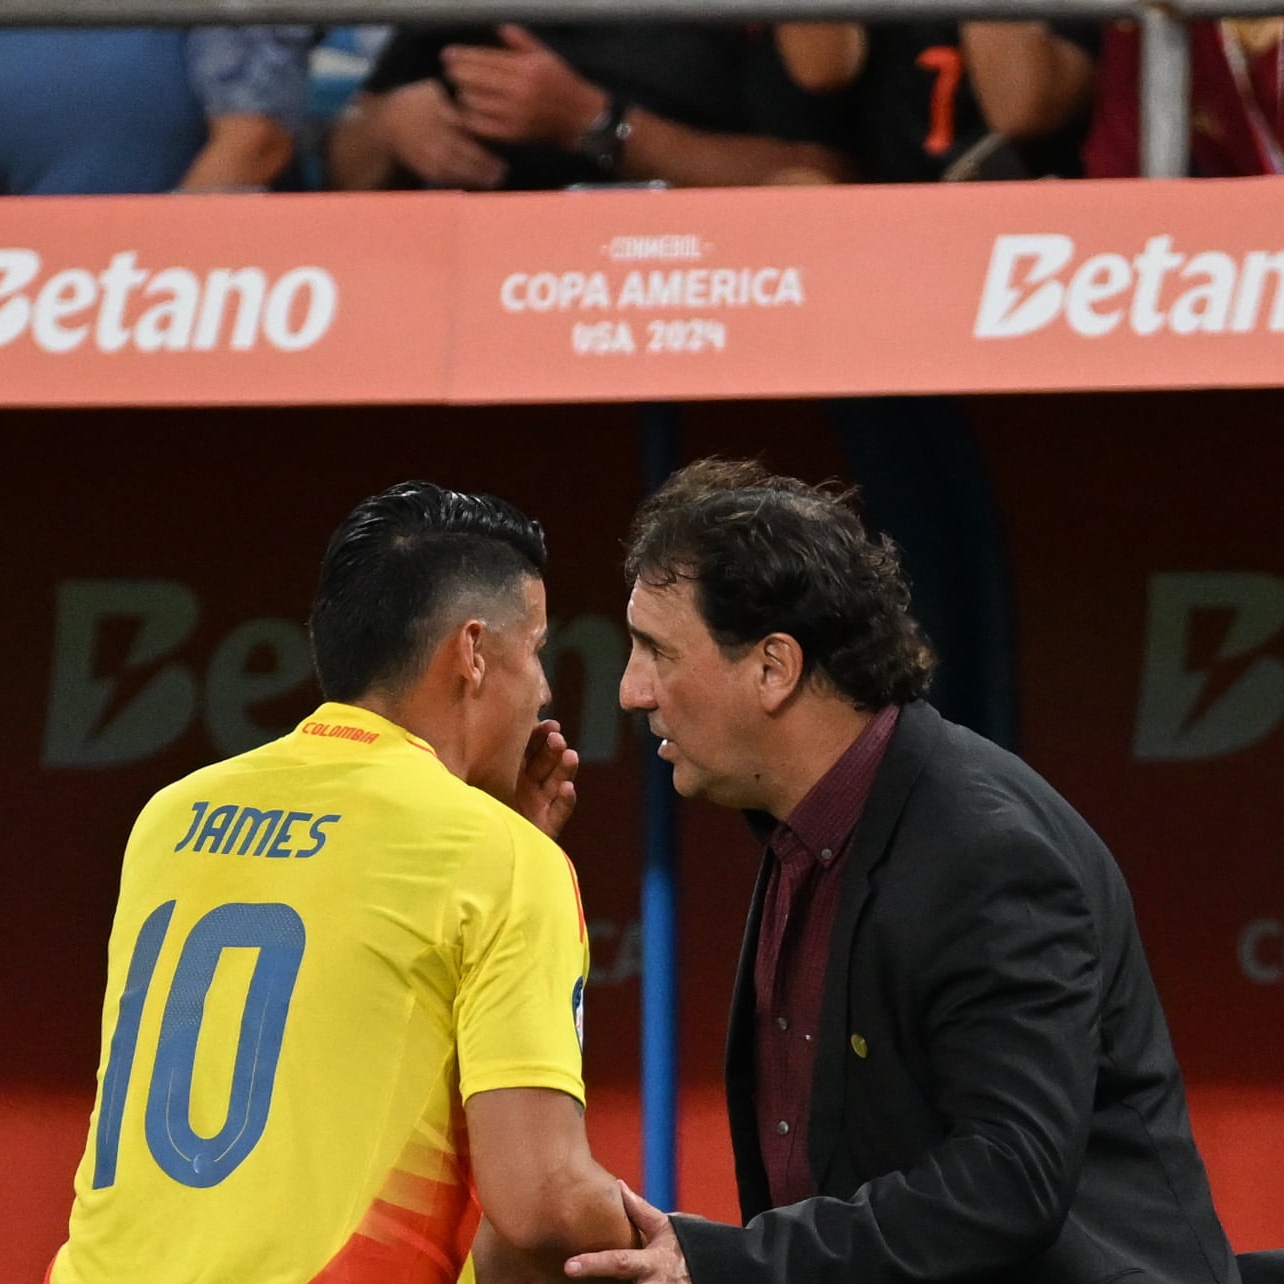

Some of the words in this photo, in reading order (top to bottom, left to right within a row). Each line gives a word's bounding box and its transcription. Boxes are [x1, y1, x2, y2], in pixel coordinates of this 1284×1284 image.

[501, 272, 610, 312] COPA
[618, 268, 803, 308] AMERICA
[572, 322, 635, 354] USA
[647, 320, 726, 353] 2024
[302, 722, 380, 744] COLOMBIA
[175, 801, 341, 858] JAMES
[93, 899, 306, 1189] 10
